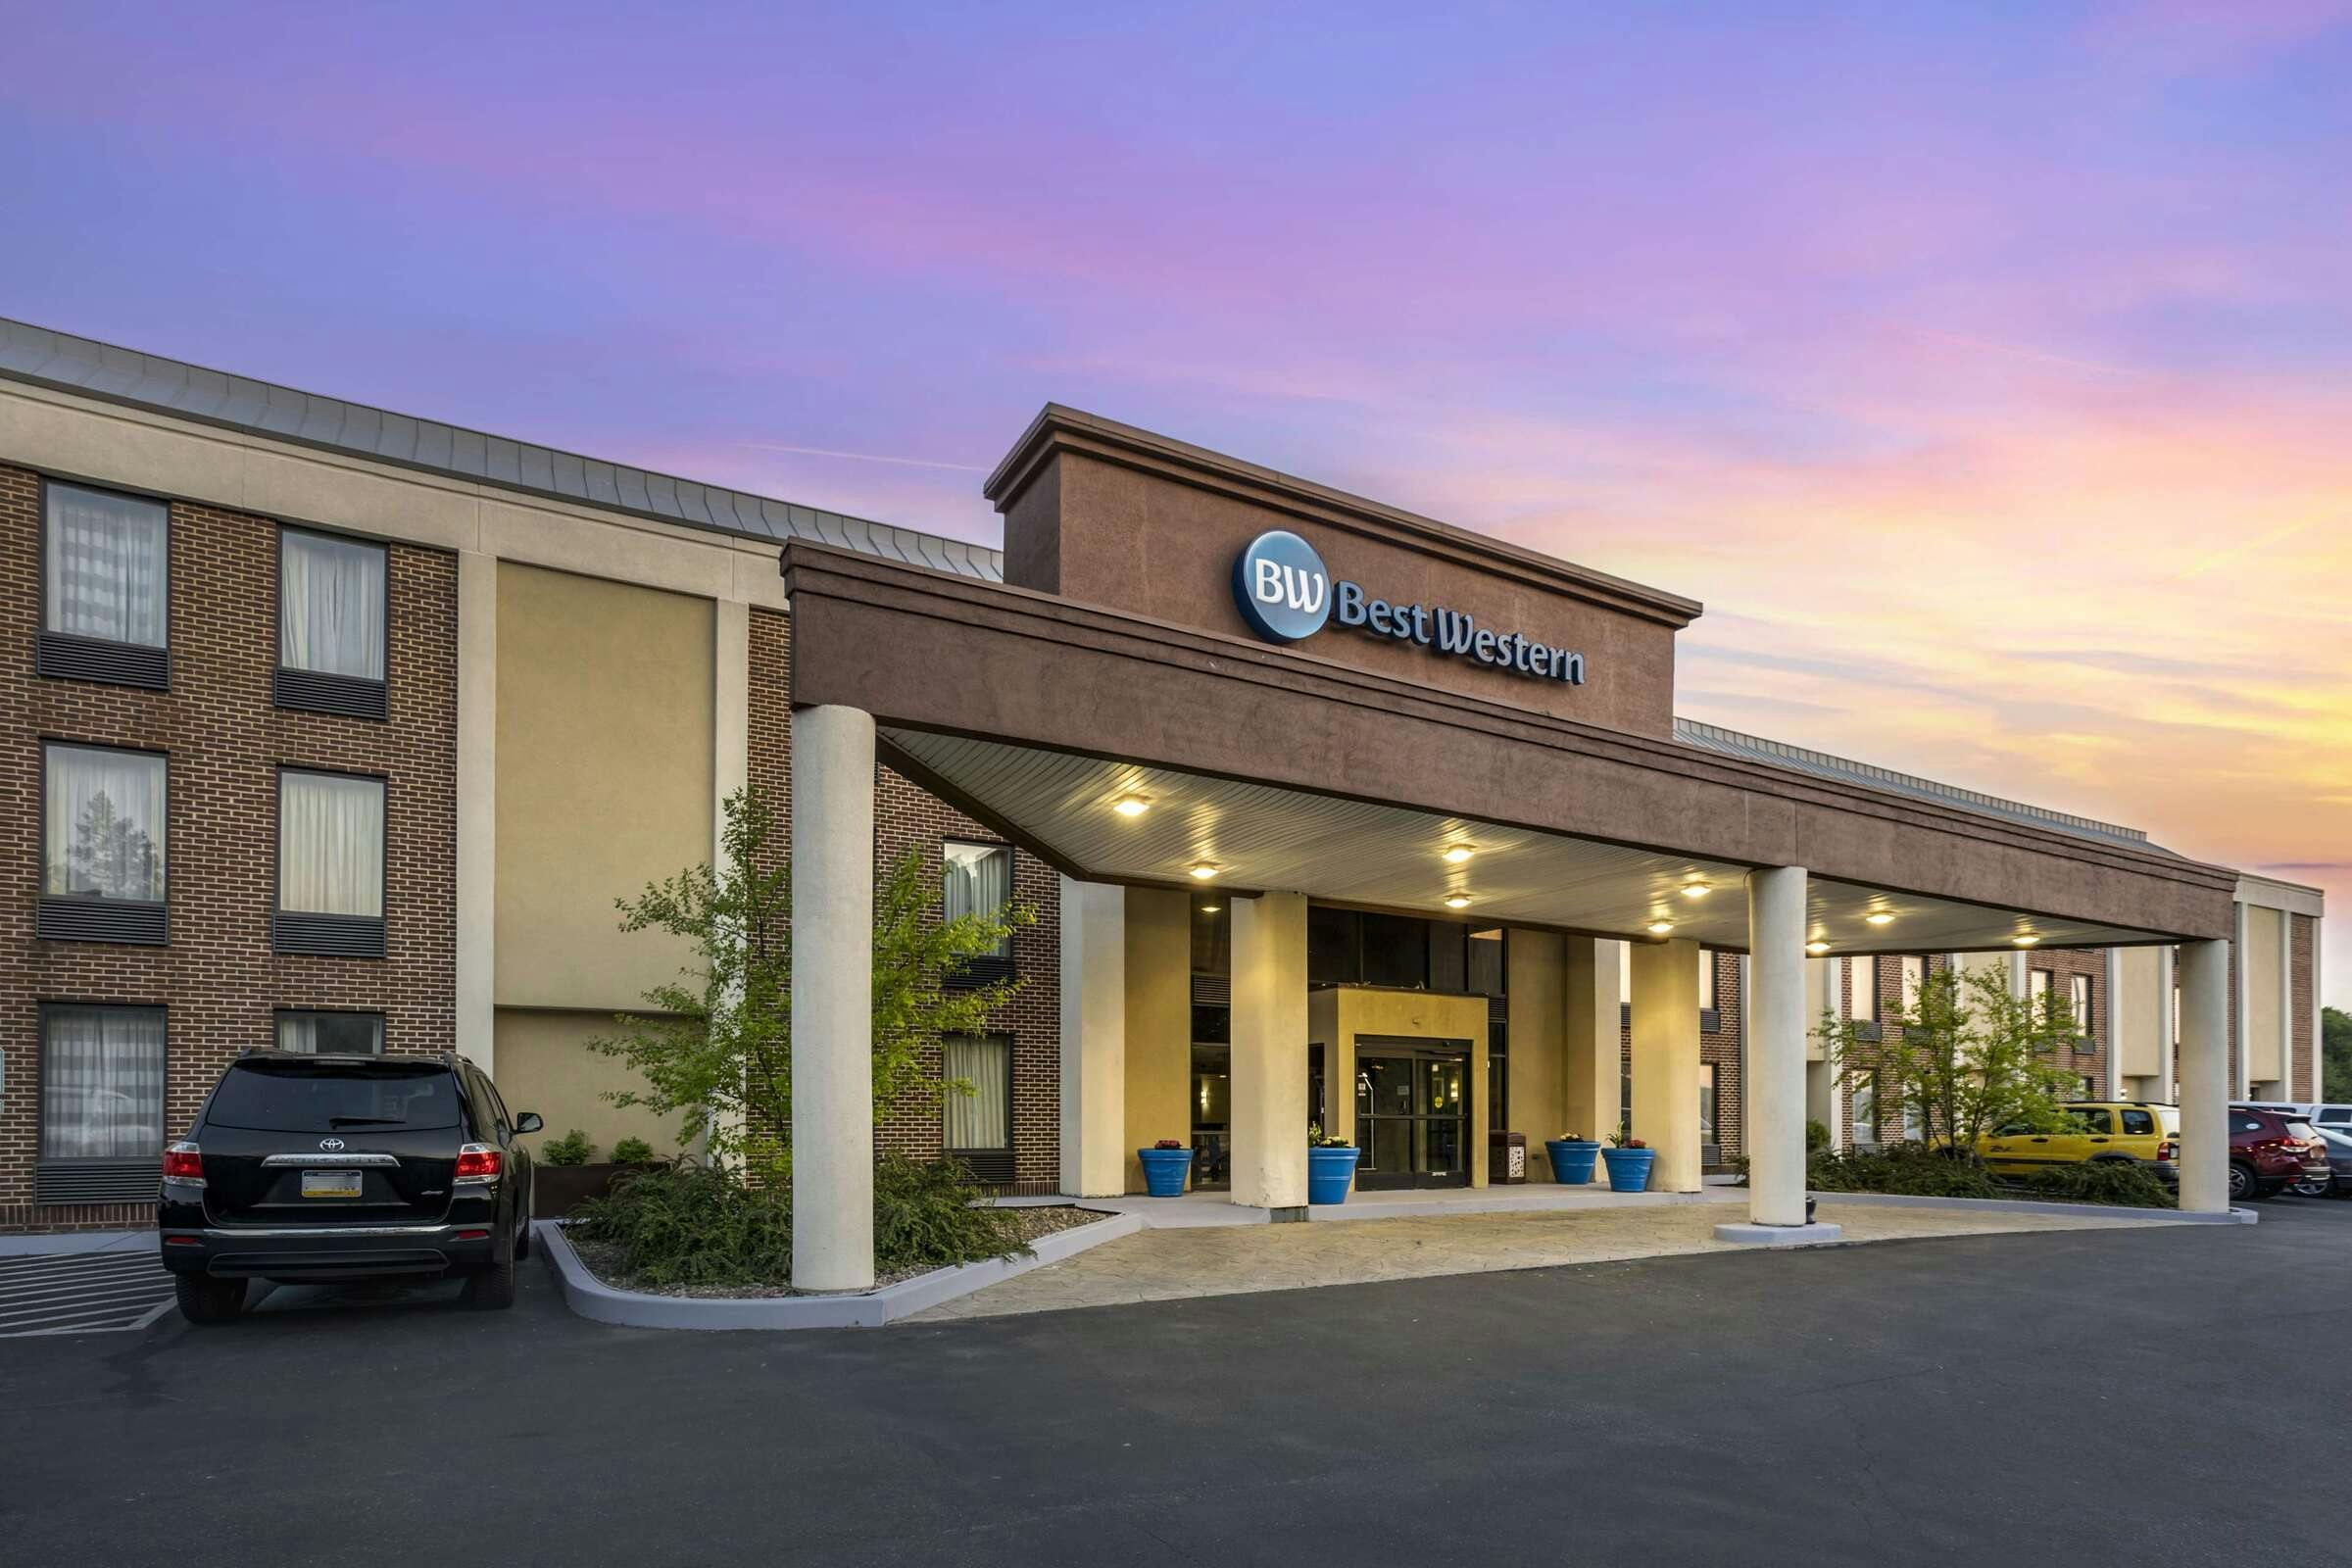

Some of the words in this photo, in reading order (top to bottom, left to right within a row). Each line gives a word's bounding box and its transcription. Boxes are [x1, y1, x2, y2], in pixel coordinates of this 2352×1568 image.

[1255, 558, 1324, 613] BW
[1334, 580, 1430, 644] Best
[1433, 606, 1585, 685] Western
